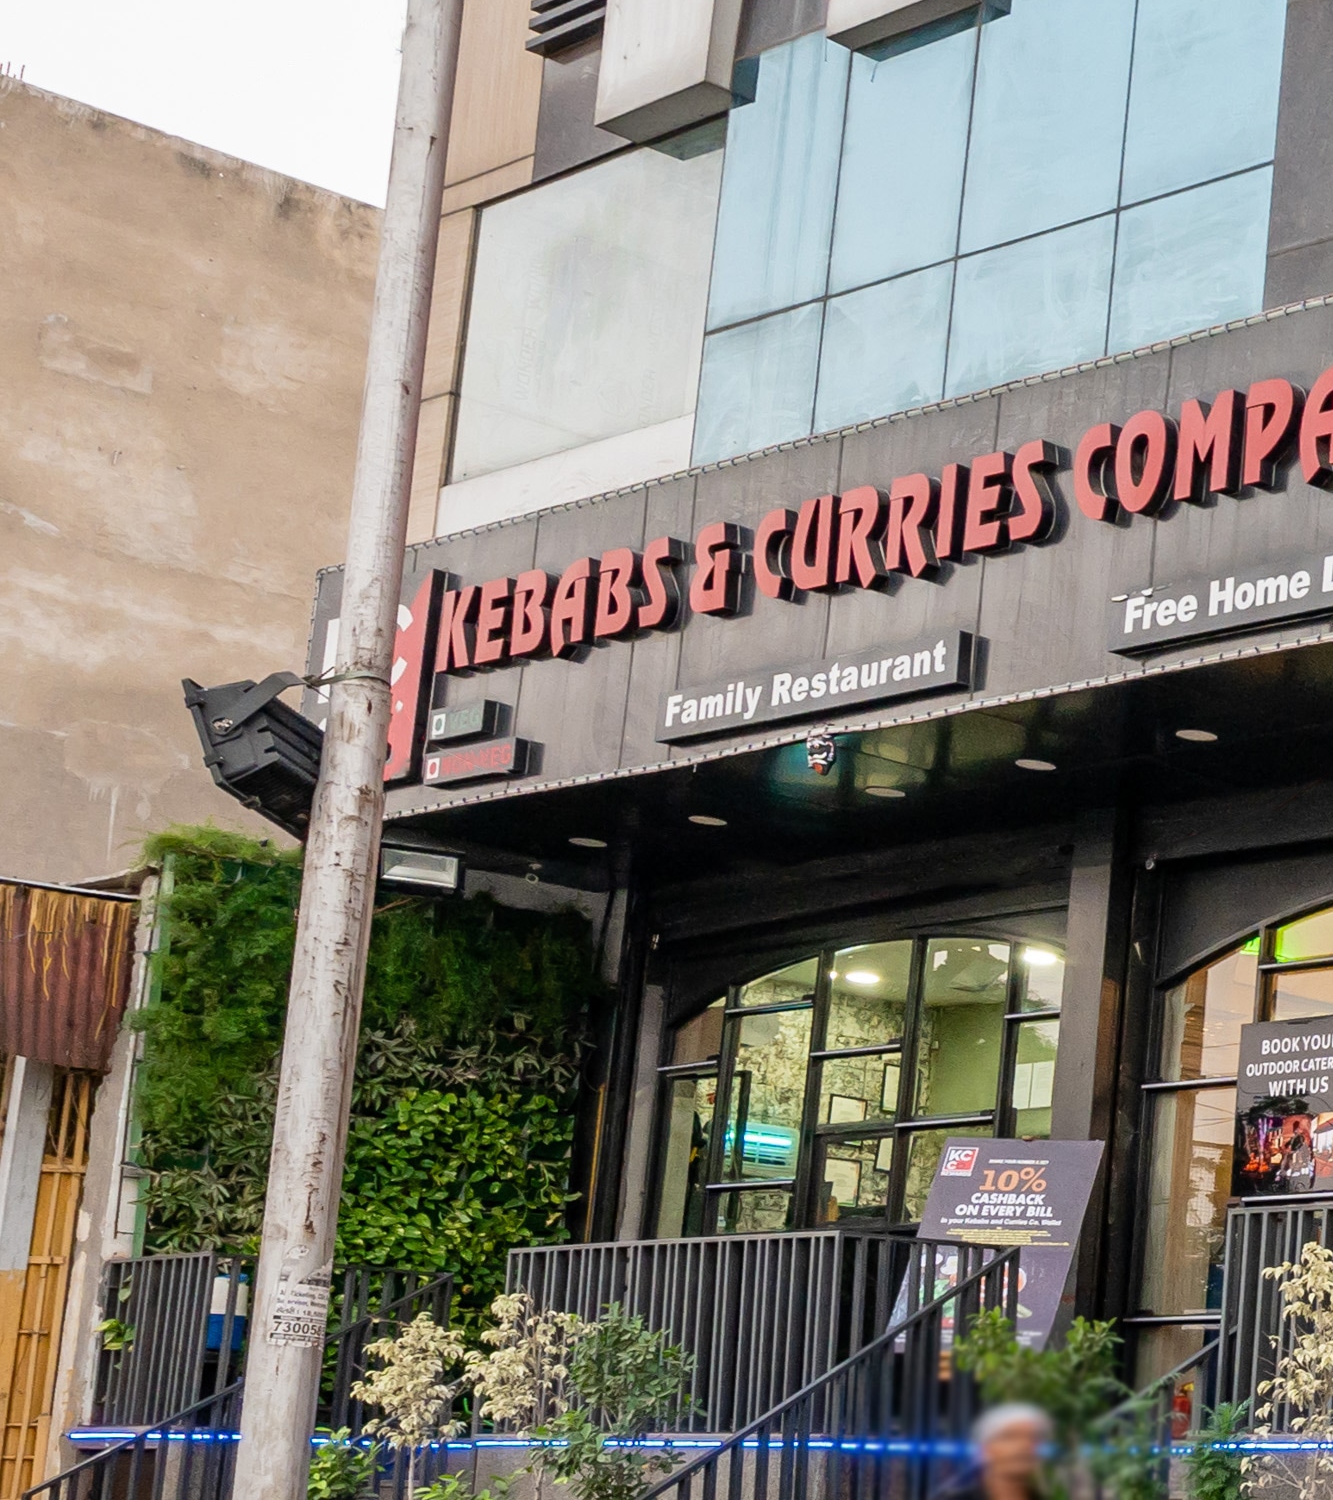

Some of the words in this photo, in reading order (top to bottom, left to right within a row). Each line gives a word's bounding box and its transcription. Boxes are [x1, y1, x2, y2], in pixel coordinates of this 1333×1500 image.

[434, 536, 674, 673] KEBABS
[691, 522, 742, 614] &
[754, 440, 1048, 600] CURRIES
[1123, 591, 1197, 633] Free
[1208, 569, 1311, 617] Home
[664, 682, 763, 727] Family
[770, 640, 947, 707] Restaurant
[1261, 1037, 1300, 1055] BOOK
[1246, 1060, 1300, 1077] OUTDOOR
[1269, 1078, 1306, 1097] WITH
[1309, 1076, 1329, 1094] US
[979, 1167, 1047, 1193] 10%
[970, 1193, 1046, 1205] CASHBACK
[955, 1204, 979, 1216] ON
[981, 1205, 1025, 1217] EVERY
[1026, 1206, 1053, 1217] BILL
